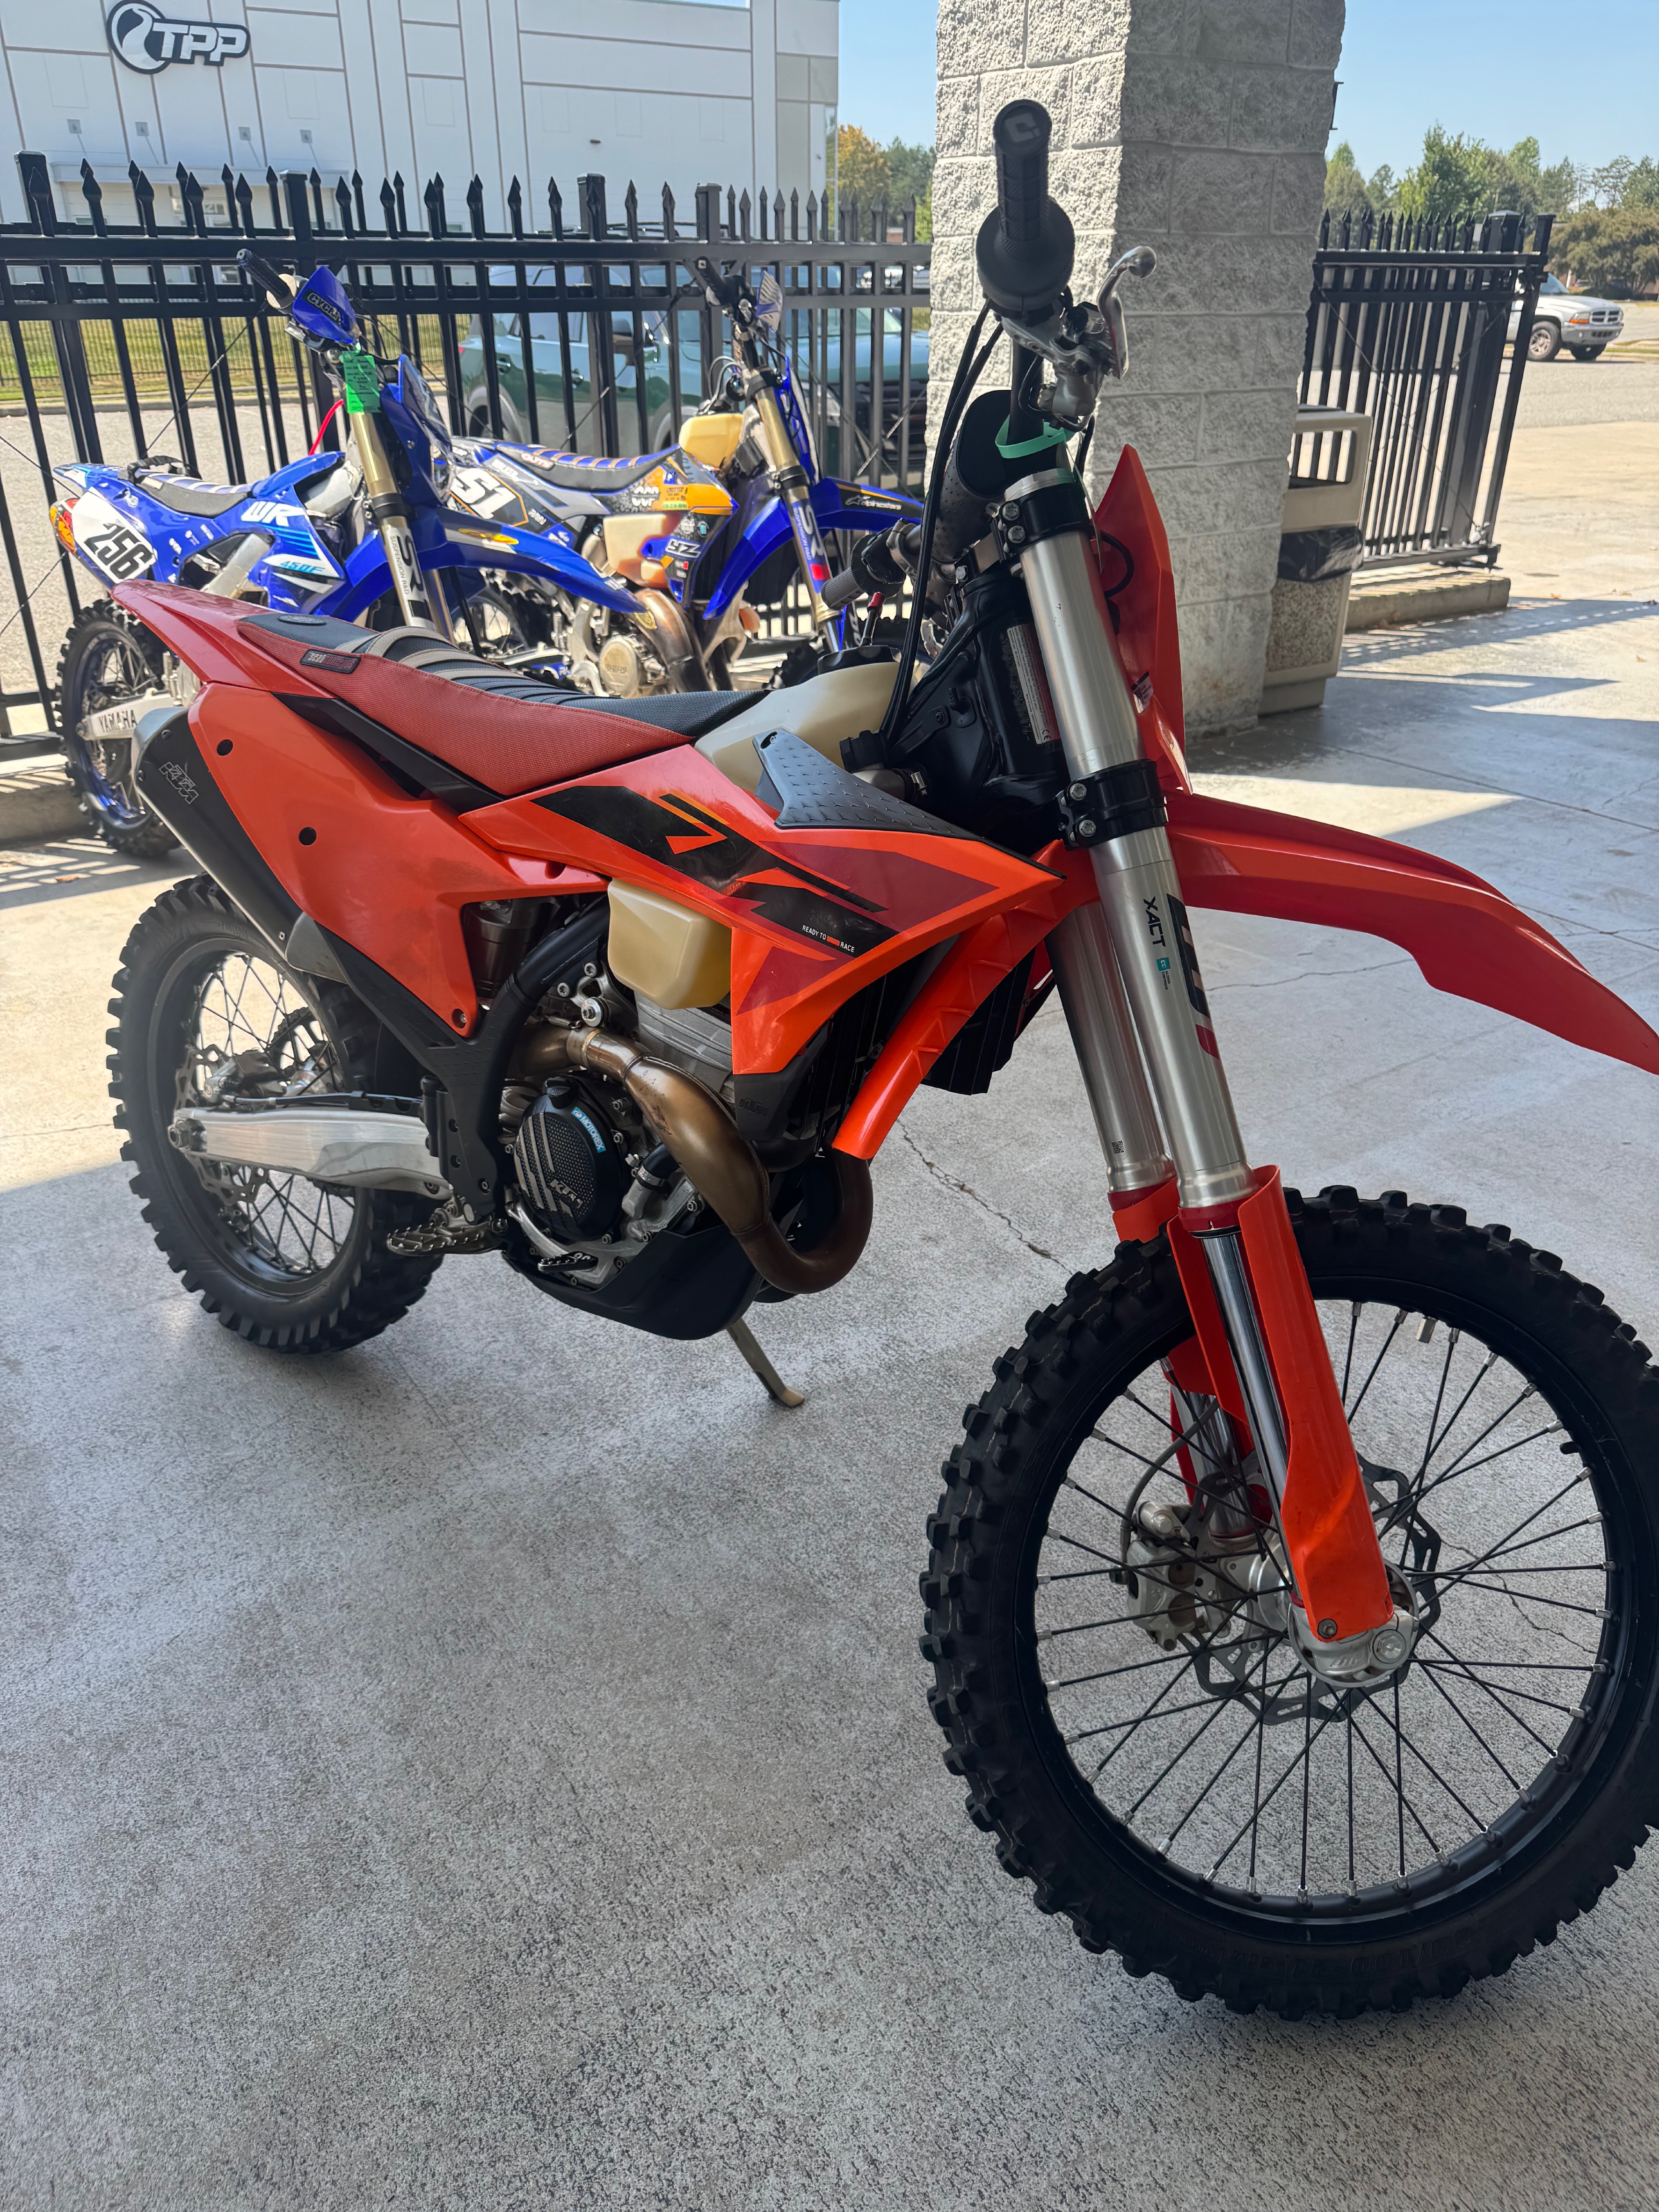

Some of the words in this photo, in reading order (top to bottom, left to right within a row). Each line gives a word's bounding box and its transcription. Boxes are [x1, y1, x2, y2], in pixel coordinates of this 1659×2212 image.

[152, 22, 247, 61] TPP
[450, 468, 516, 519] 51
[241, 504, 305, 527] WR
[793, 507, 808, 548] SUSPENSION
[84, 519, 153, 580] 256
[280, 561, 326, 573] 450F
[390, 536, 406, 579] SUSPENSION
[99, 710, 138, 733] YAMAHA
[159, 762, 199, 805] KTM
[802, 925, 819, 936] READY
[820, 932, 827, 940] TO
[840, 942, 855, 953] RACE
[1143, 896, 1166, 947] XACT
[580, 1116, 604, 1151] MOTOREX
